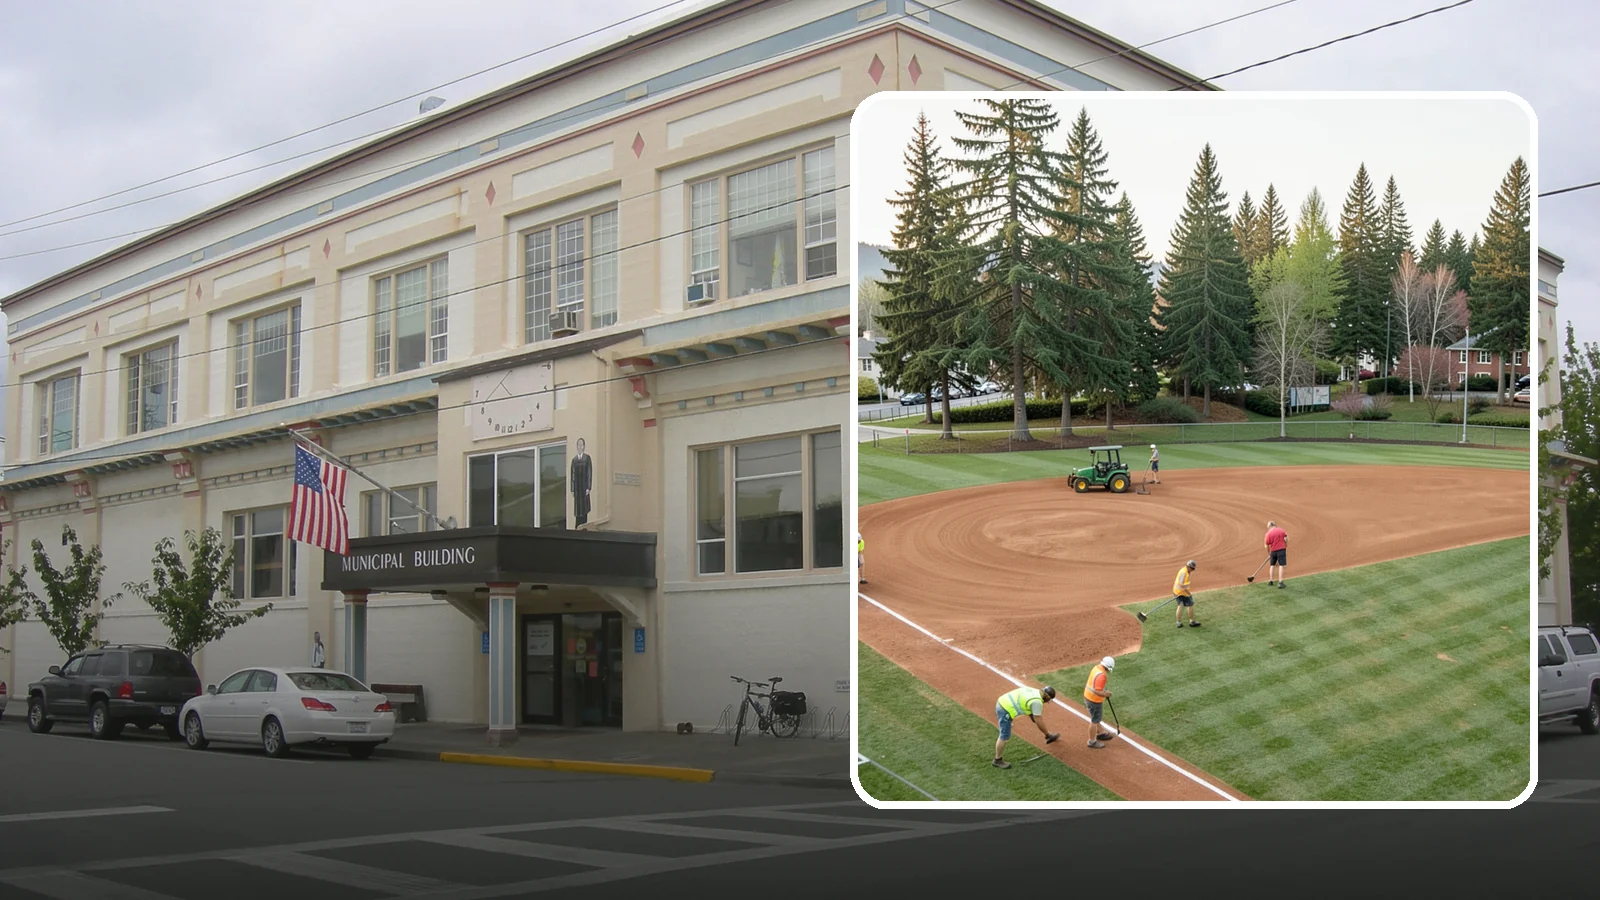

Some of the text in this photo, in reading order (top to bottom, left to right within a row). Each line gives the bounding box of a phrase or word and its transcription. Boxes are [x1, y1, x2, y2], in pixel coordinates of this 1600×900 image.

[536, 402, 540, 410] 4
[481, 407, 484, 415] 8
[488, 418, 492, 426] 9
[529, 414, 532, 422] 3
[495, 424, 500, 432] 10
[508, 425, 513, 433] 12
[342, 546, 475, 572] MUNICIPAL BUILDING
